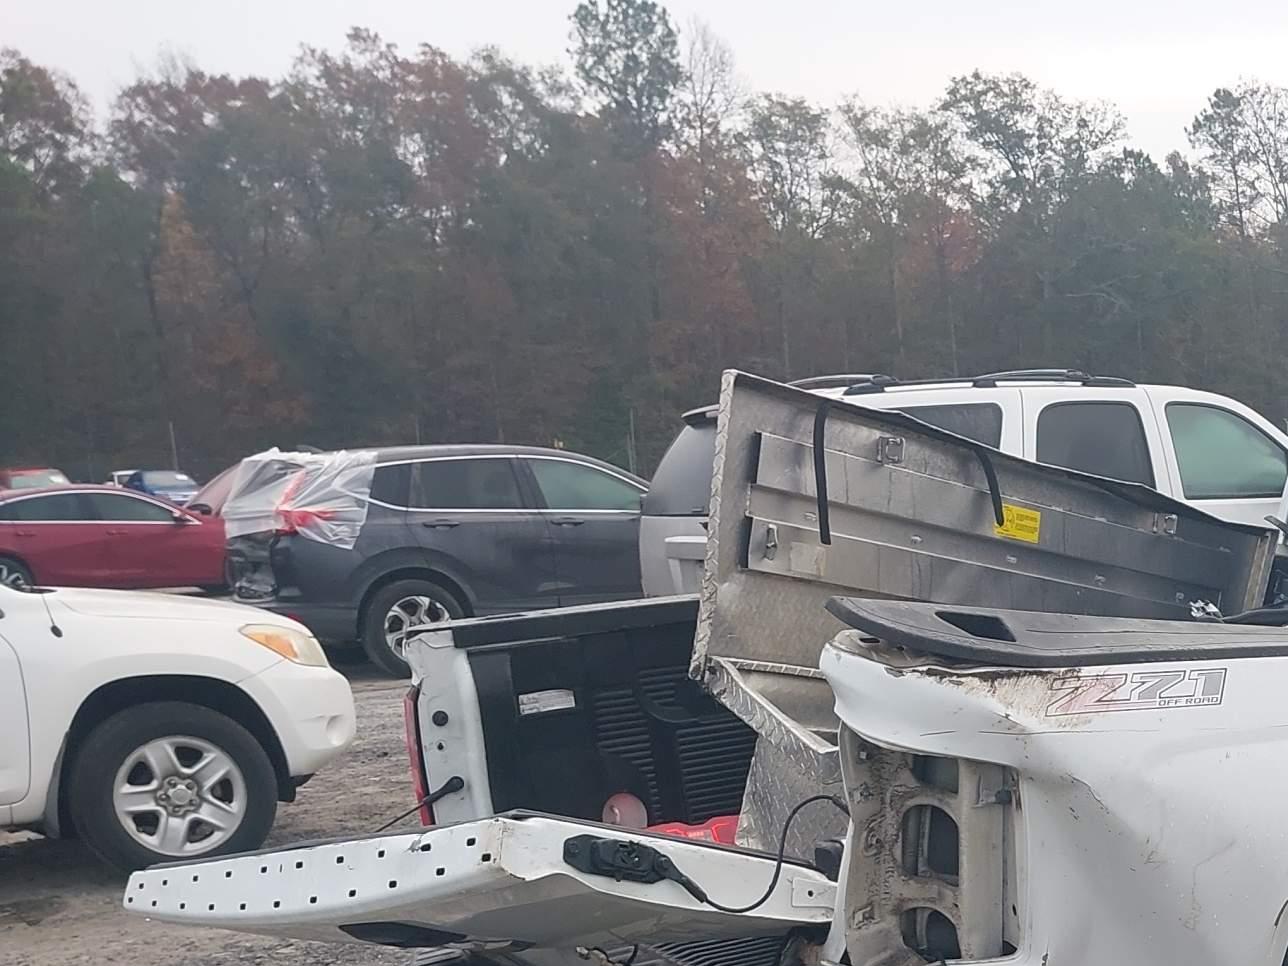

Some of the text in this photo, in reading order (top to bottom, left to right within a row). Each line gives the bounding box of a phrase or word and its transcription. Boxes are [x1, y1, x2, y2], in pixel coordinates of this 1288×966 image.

[1045, 667, 1228, 718] Z71
[1157, 695, 1220, 707] OFF ROAD
